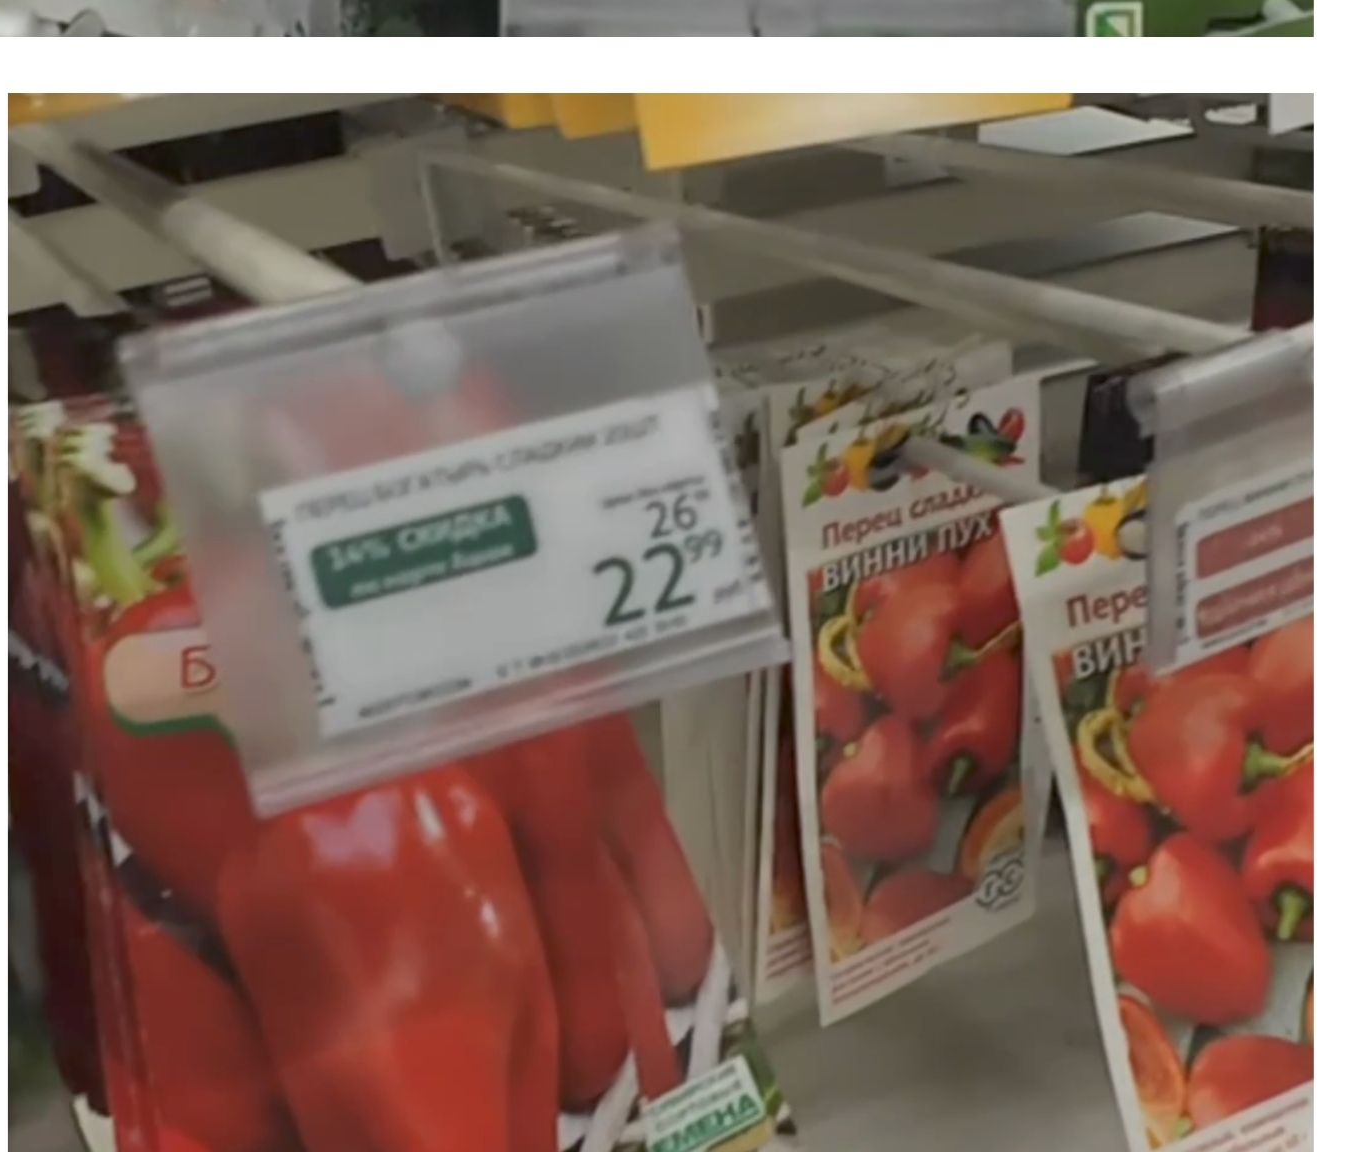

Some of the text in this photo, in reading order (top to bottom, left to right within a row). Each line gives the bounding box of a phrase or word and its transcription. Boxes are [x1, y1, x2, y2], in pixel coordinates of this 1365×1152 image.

[821, 508, 905, 550] Перец
[821, 508, 1001, 593] ВИННИ ПУХ
[1065, 583, 1148, 629] Пере
[180, 646, 217, 689] Б
